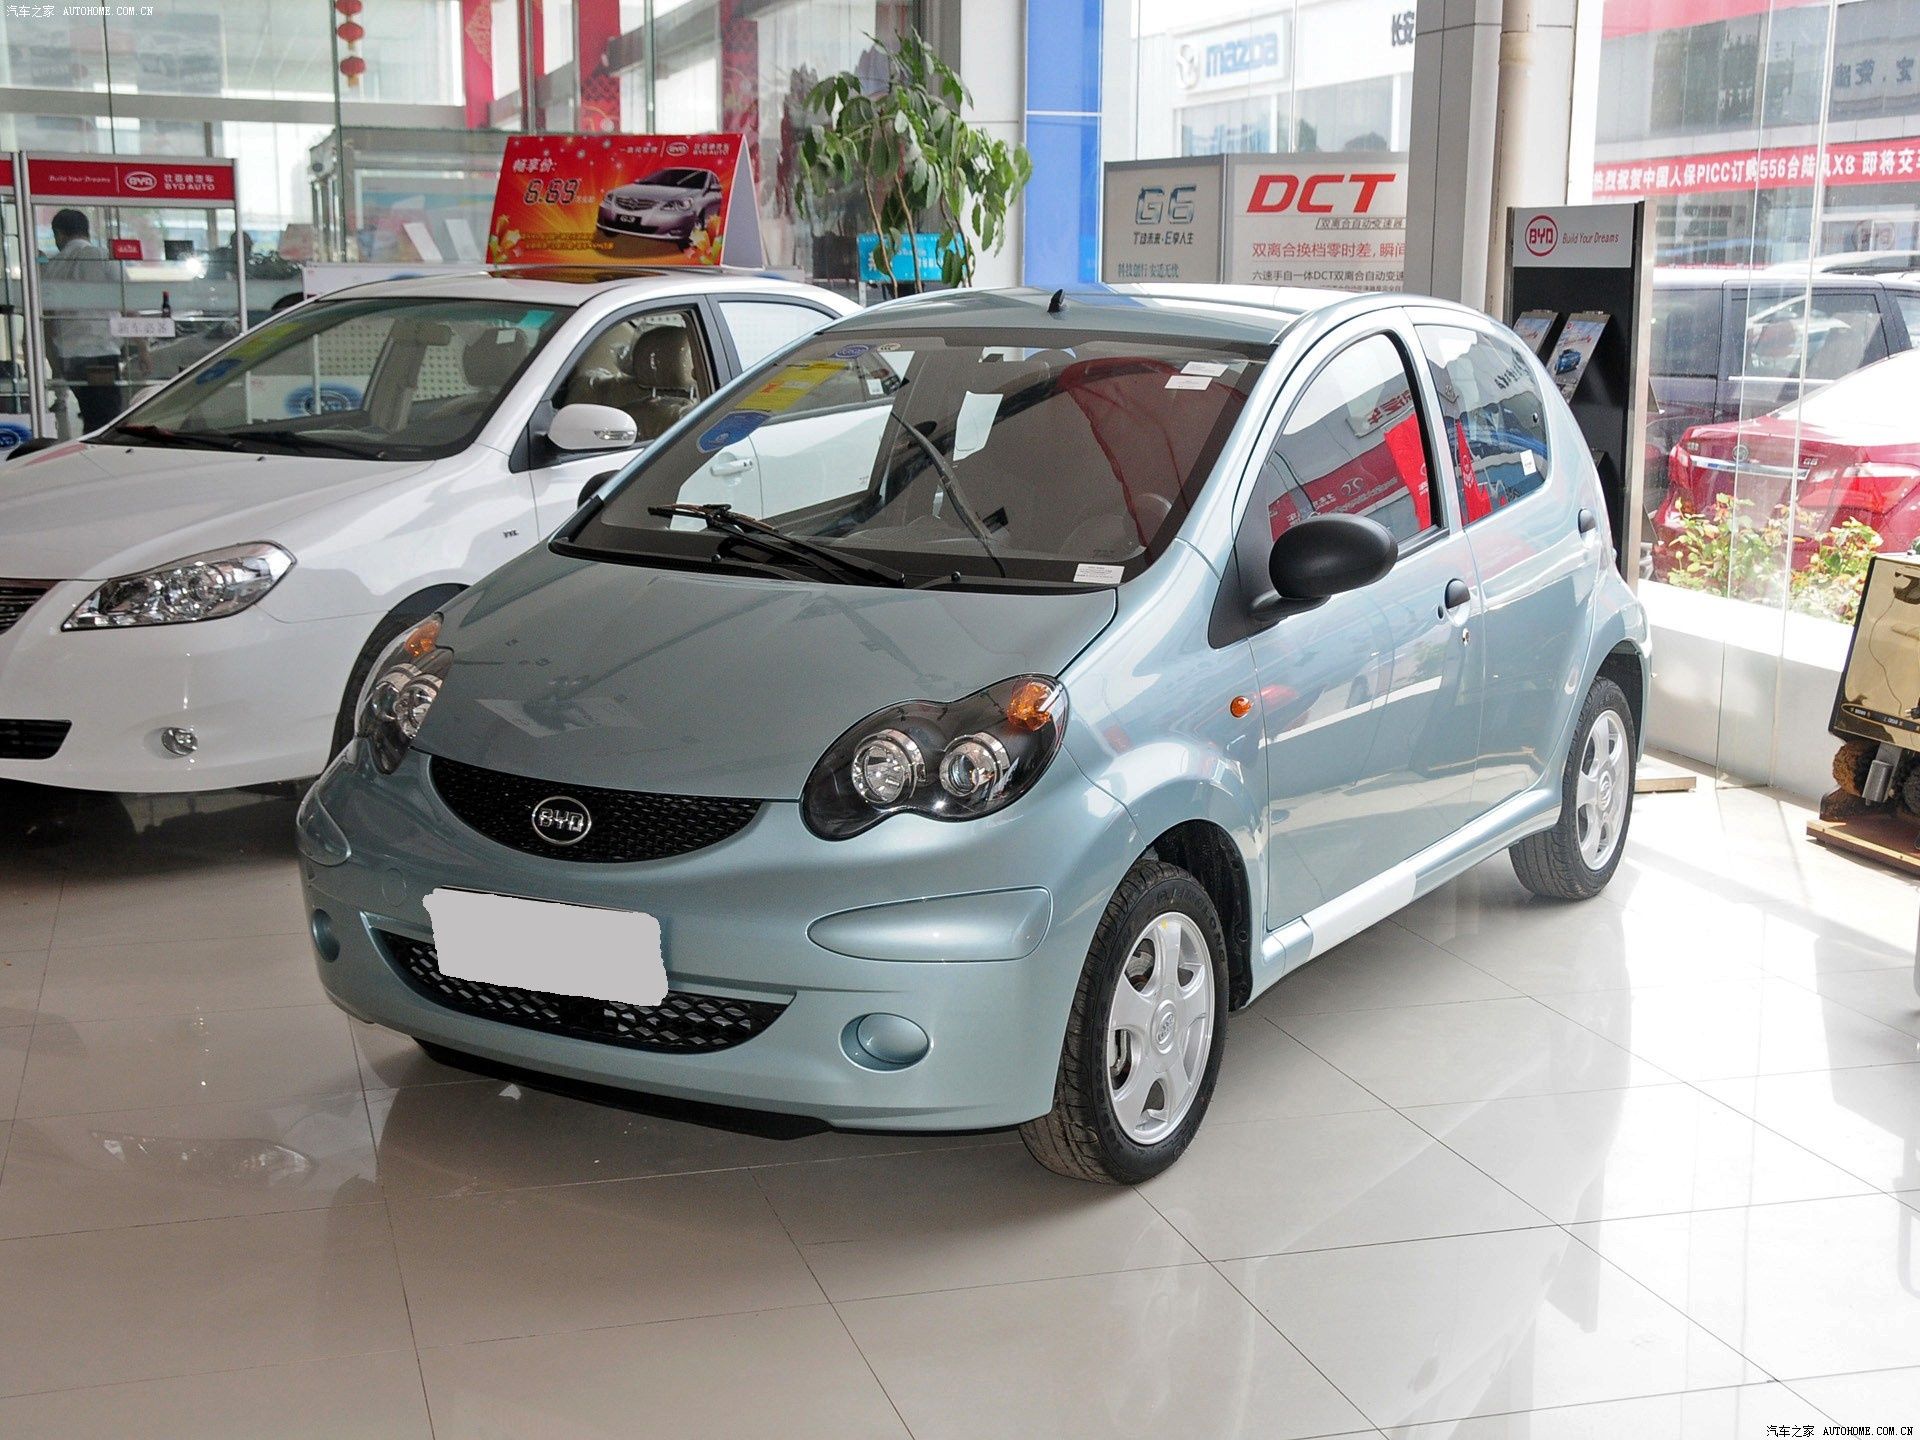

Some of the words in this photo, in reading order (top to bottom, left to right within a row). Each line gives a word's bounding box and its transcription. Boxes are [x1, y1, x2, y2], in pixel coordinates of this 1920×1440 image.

[1206, 33, 1278, 78] mazda
[1861, 149, 1920, 175] 即将交
[85, 176, 111, 184] Dreams
[188, 183, 215, 191] AUTO
[1135, 185, 1197, 225] G6
[1246, 174, 1396, 213] DCT
[1529, 229, 1554, 244] BYD
[1562, 233, 1578, 244] Build
[1580, 233, 1593, 244] Your
[1594, 232, 1619, 244] Dreams
[539, 808, 584, 832] BYD
